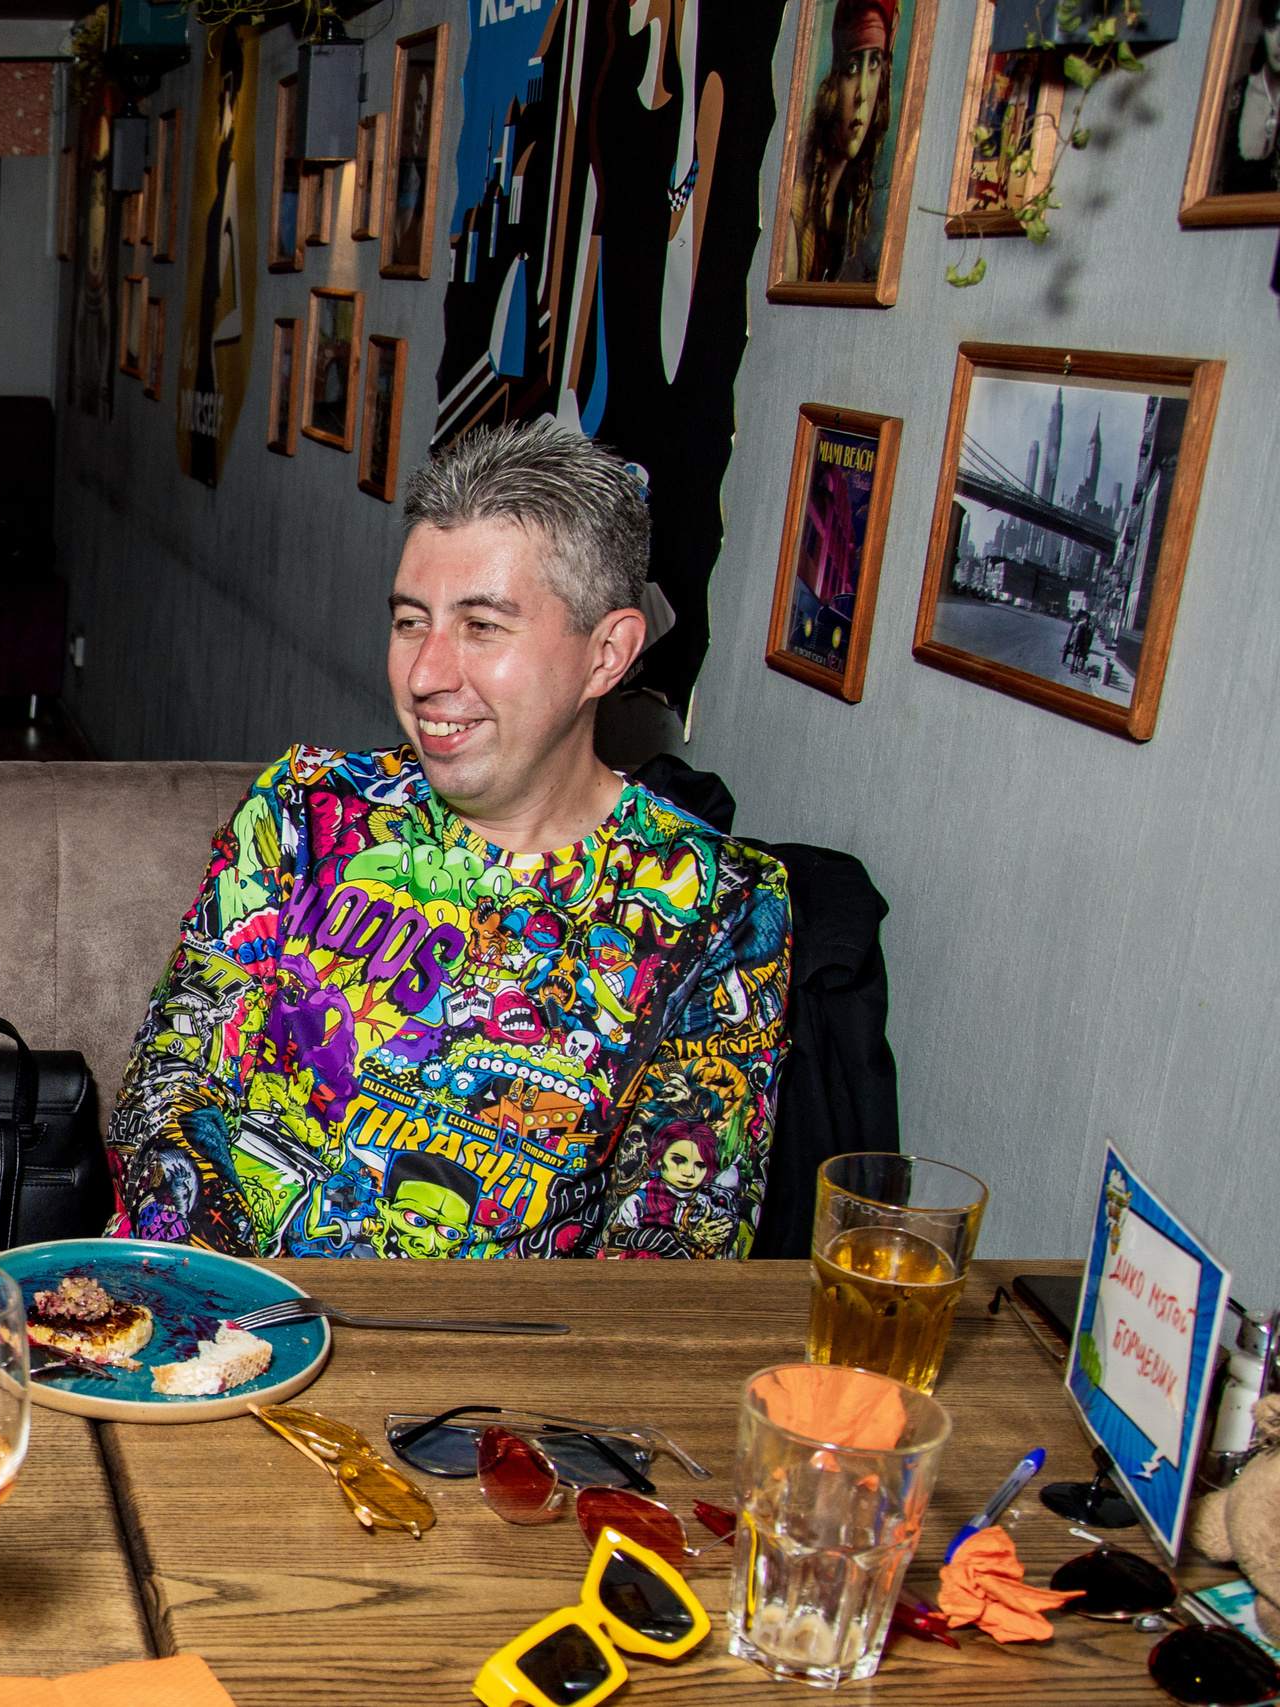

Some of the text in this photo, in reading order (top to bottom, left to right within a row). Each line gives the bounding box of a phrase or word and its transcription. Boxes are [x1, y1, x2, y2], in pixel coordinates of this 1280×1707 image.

[817, 440, 875, 472] MIAMI BEACH
[447, 1113, 498, 1141] CLOTHING
[521, 1141, 566, 1168] COMPANY
[1109, 1254, 1145, 1299] ДИКО
